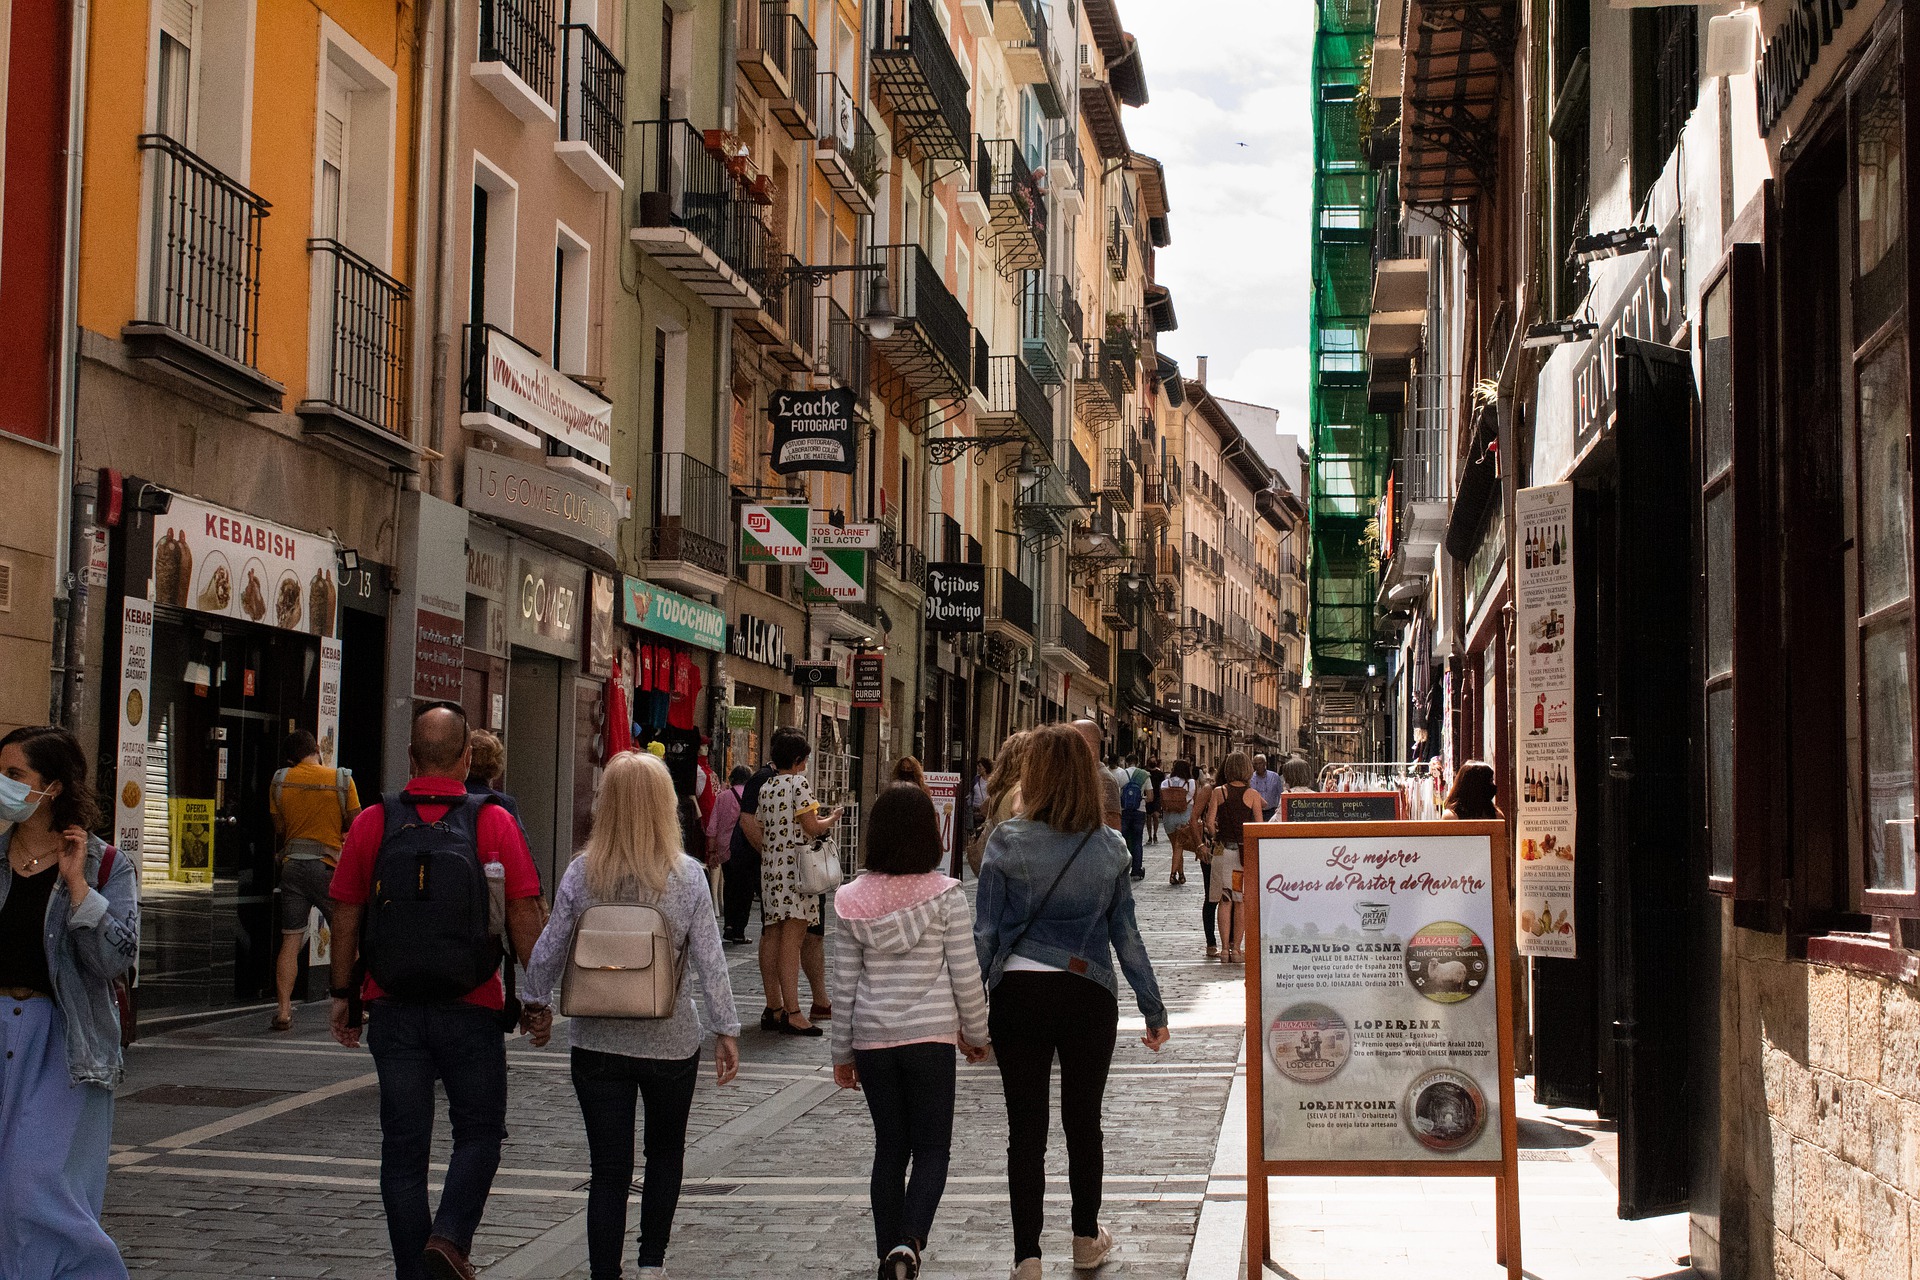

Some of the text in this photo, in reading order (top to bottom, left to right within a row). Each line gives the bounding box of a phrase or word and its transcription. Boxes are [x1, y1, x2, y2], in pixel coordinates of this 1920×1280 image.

[778, 395, 840, 417] Leache
[791, 419, 847, 432] FOTOGRAFO
[785, 440, 806, 449] ESTUDIO
[478, 467, 498, 498] 15
[505, 475, 560, 516] GOMEZ
[205, 513, 296, 561] KEBABISH
[359, 570, 371, 598] 13
[929, 571, 980, 597] Tejidos
[522, 573, 574, 630] GOMEZ
[925, 597, 981, 622] Rodrigo
[125, 608, 152, 626] KEBAB
[656, 595, 723, 638] TODOCHINO
[124, 625, 151, 637] ESTAFETA
[129, 645, 145, 657] PLATO
[321, 646, 341, 661] KEBAB
[127, 656, 146, 668] ARROZ
[125, 668, 148, 680] BASMATI
[323, 680, 338, 693] MENÚ
[323, 693, 338, 704] KEBAB
[856, 690, 881, 698] GURGUR
[321, 704, 338, 717] FALAFEL
[122, 742, 145, 754] PATATAS
[123, 755, 142, 767] FRITAS
[185, 803, 207, 813] OFERTA
[120, 828, 139, 839] PLATO
[120, 840, 139, 852] KEBAB
[1326, 846, 1420, 871] Los mejores
[1266, 873, 1486, 901] Quesos de Pastor de Navarra
[1362, 917, 1387, 925] GAZTA
[1356, 943, 1401, 952] GASNA
[1365, 963, 1386, 971] España
[1354, 1020, 1441, 1031] LOPERENA
[1409, 1032, 1438, 1040] Egozkue)
[1362, 1112, 1398, 1120] Orbaitzeta)
[1306, 1121, 1326, 1129] Queso
